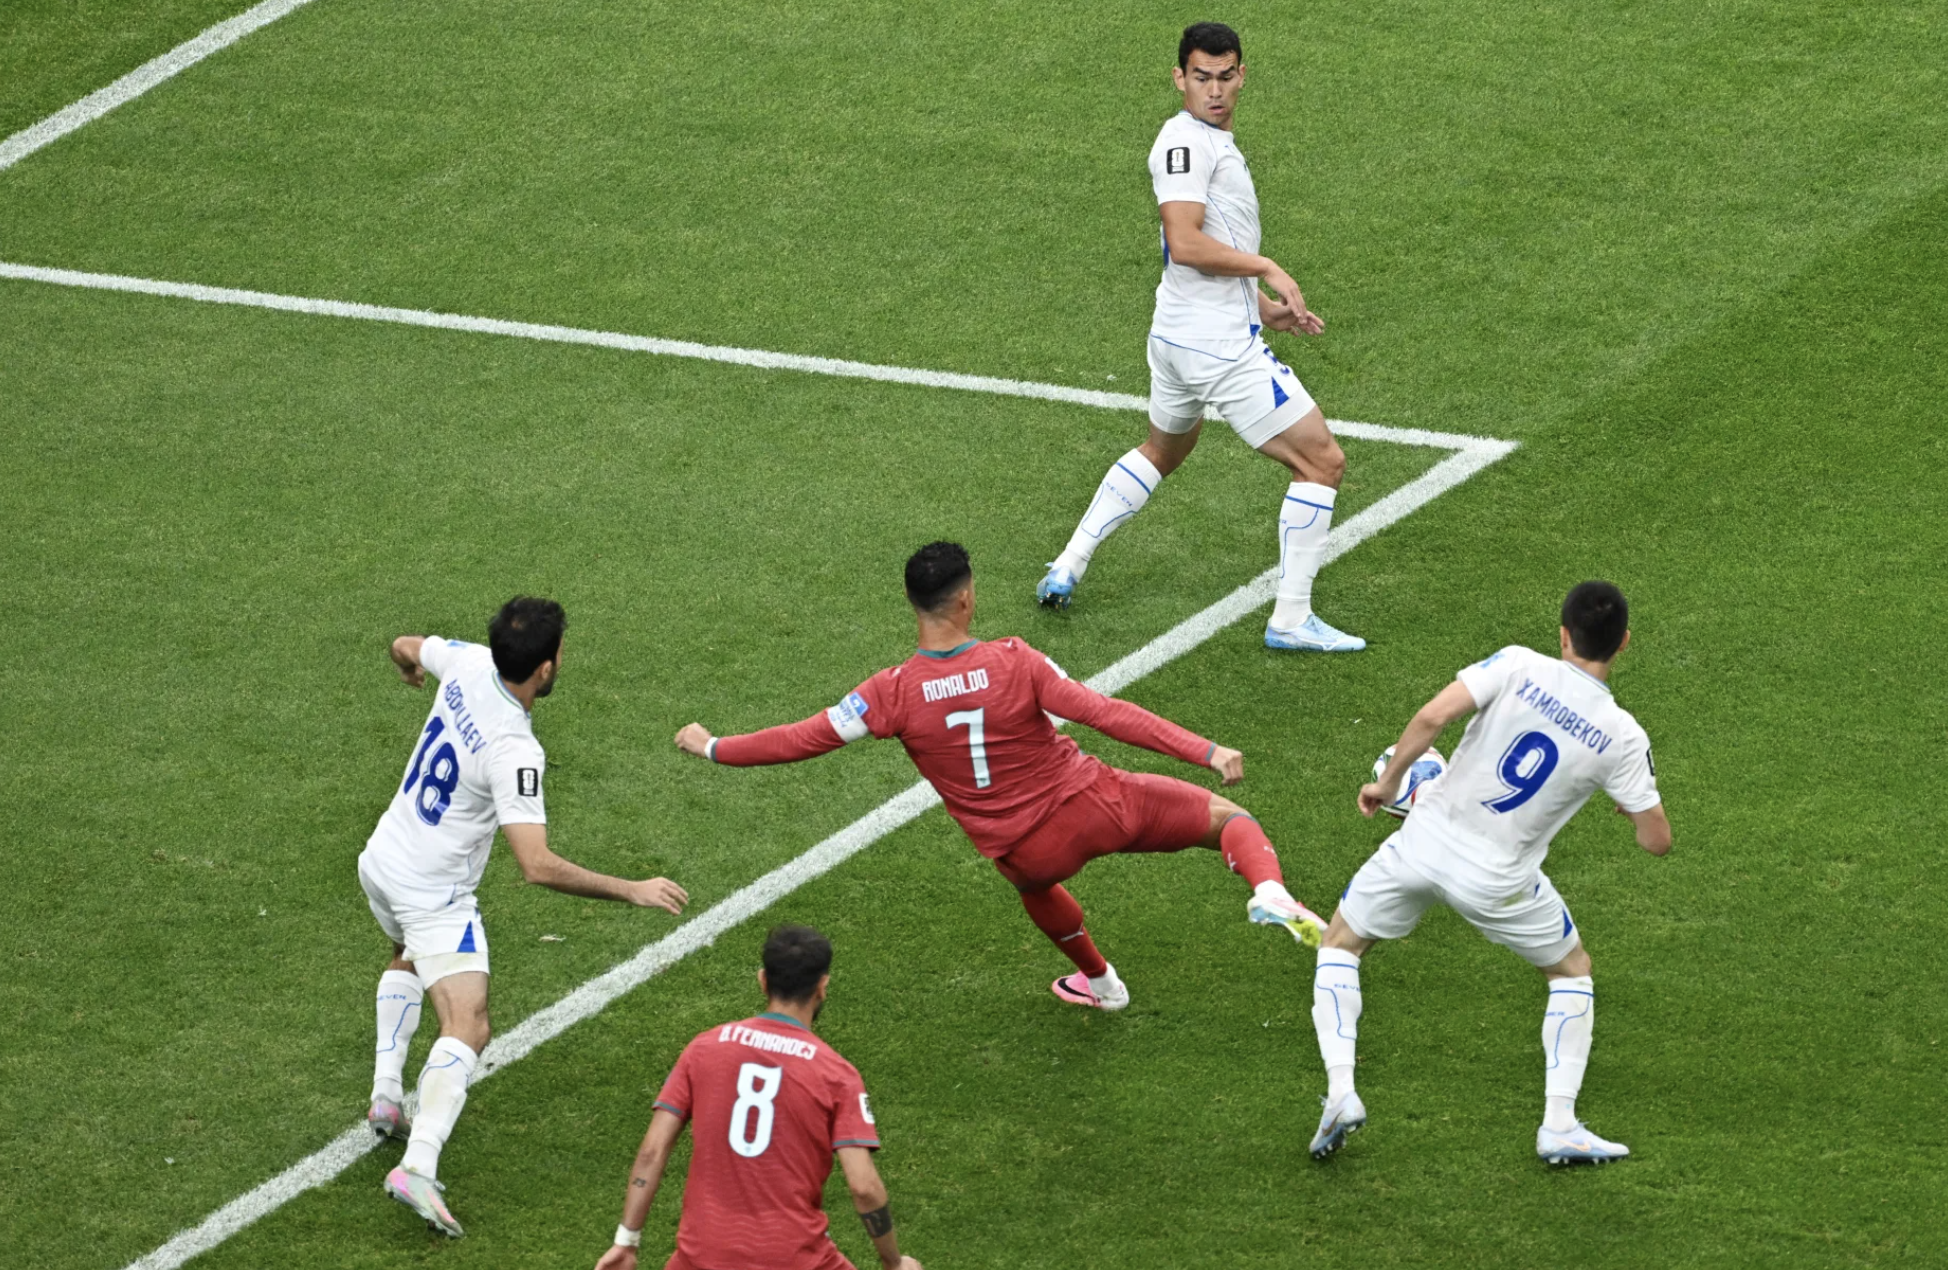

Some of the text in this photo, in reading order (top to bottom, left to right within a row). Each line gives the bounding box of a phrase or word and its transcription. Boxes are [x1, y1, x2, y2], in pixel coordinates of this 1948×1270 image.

[922, 668, 989, 702] RONALDO
[1516, 678, 1612, 755] XAMROBEKOV
[403, 716, 460, 826] 18
[945, 707, 991, 789] 7
[1480, 730, 1559, 815] 9
[728, 1062, 782, 1158] 8
